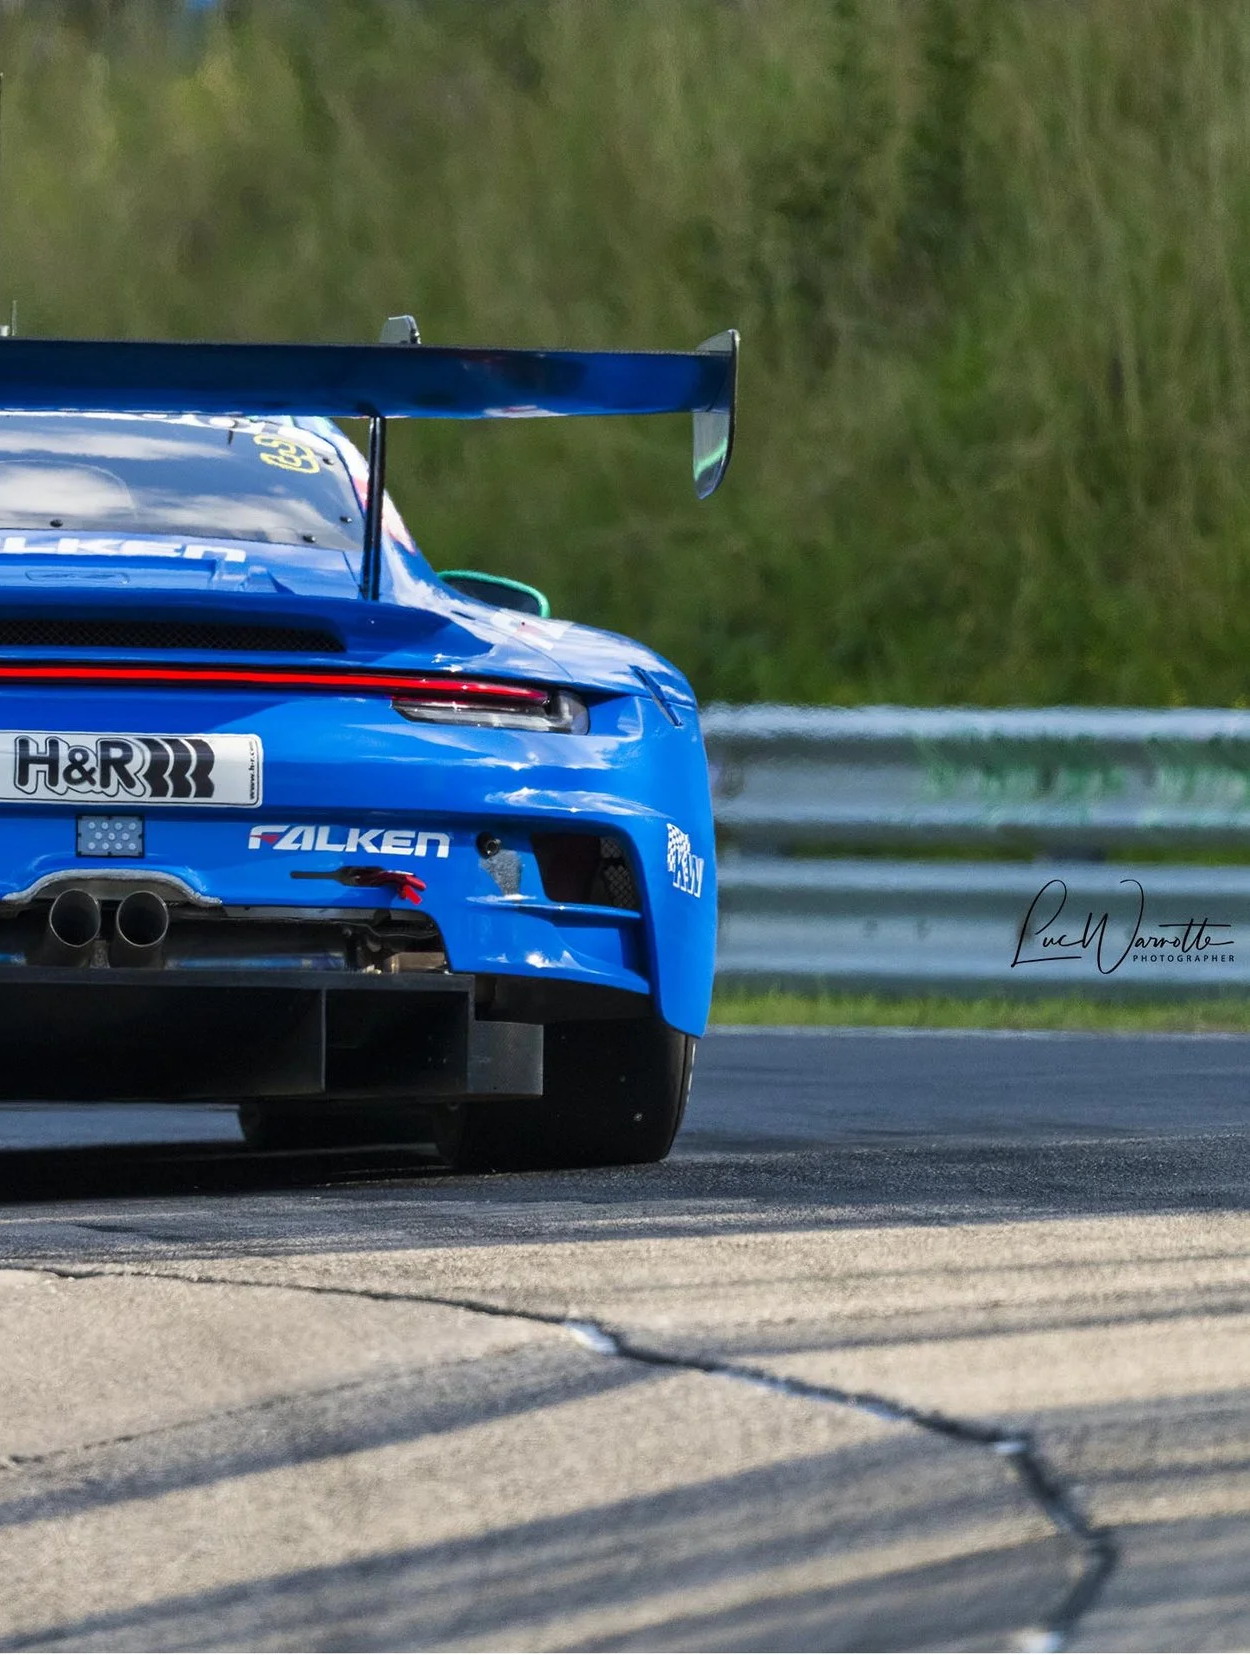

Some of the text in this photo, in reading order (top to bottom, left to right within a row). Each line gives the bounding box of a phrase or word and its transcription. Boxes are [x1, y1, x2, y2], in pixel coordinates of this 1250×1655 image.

[14, 736, 146, 797] H&R
[248, 825, 450, 858] FALKEN
[673, 848, 705, 898] KW
